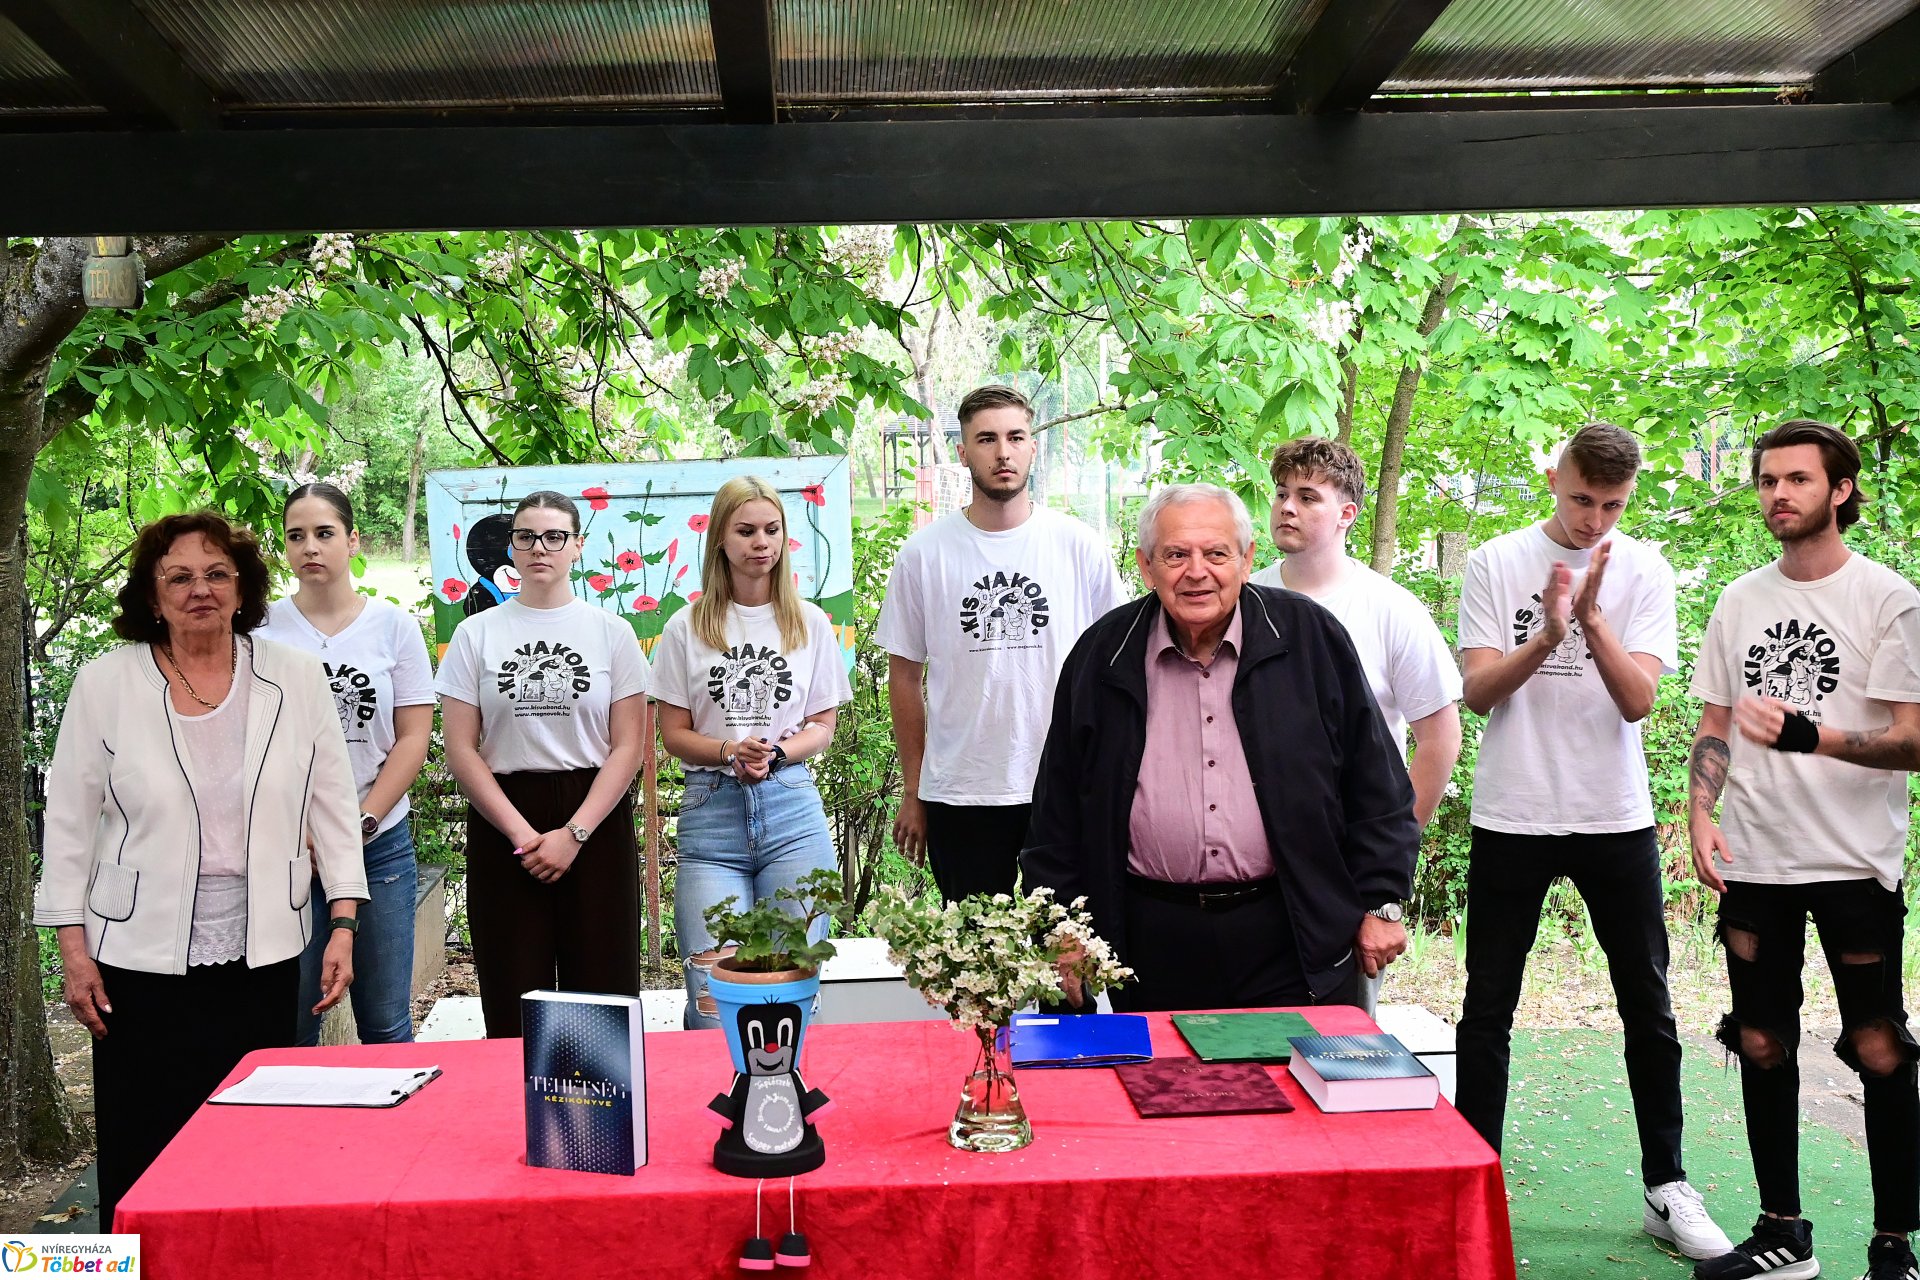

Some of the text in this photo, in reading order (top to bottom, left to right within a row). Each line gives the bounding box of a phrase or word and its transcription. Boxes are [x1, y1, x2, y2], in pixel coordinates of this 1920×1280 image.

[960, 571, 1049, 634] KIS VAKOND
[498, 640, 591, 694] KIS VAKOND
[708, 643, 793, 704] KIS VAKOND
[1744, 619, 1840, 694] KIS VAKOND
[321, 662, 377, 721] KOND
[544, 1095, 613, 1107] KÉZIKÖNYVE
